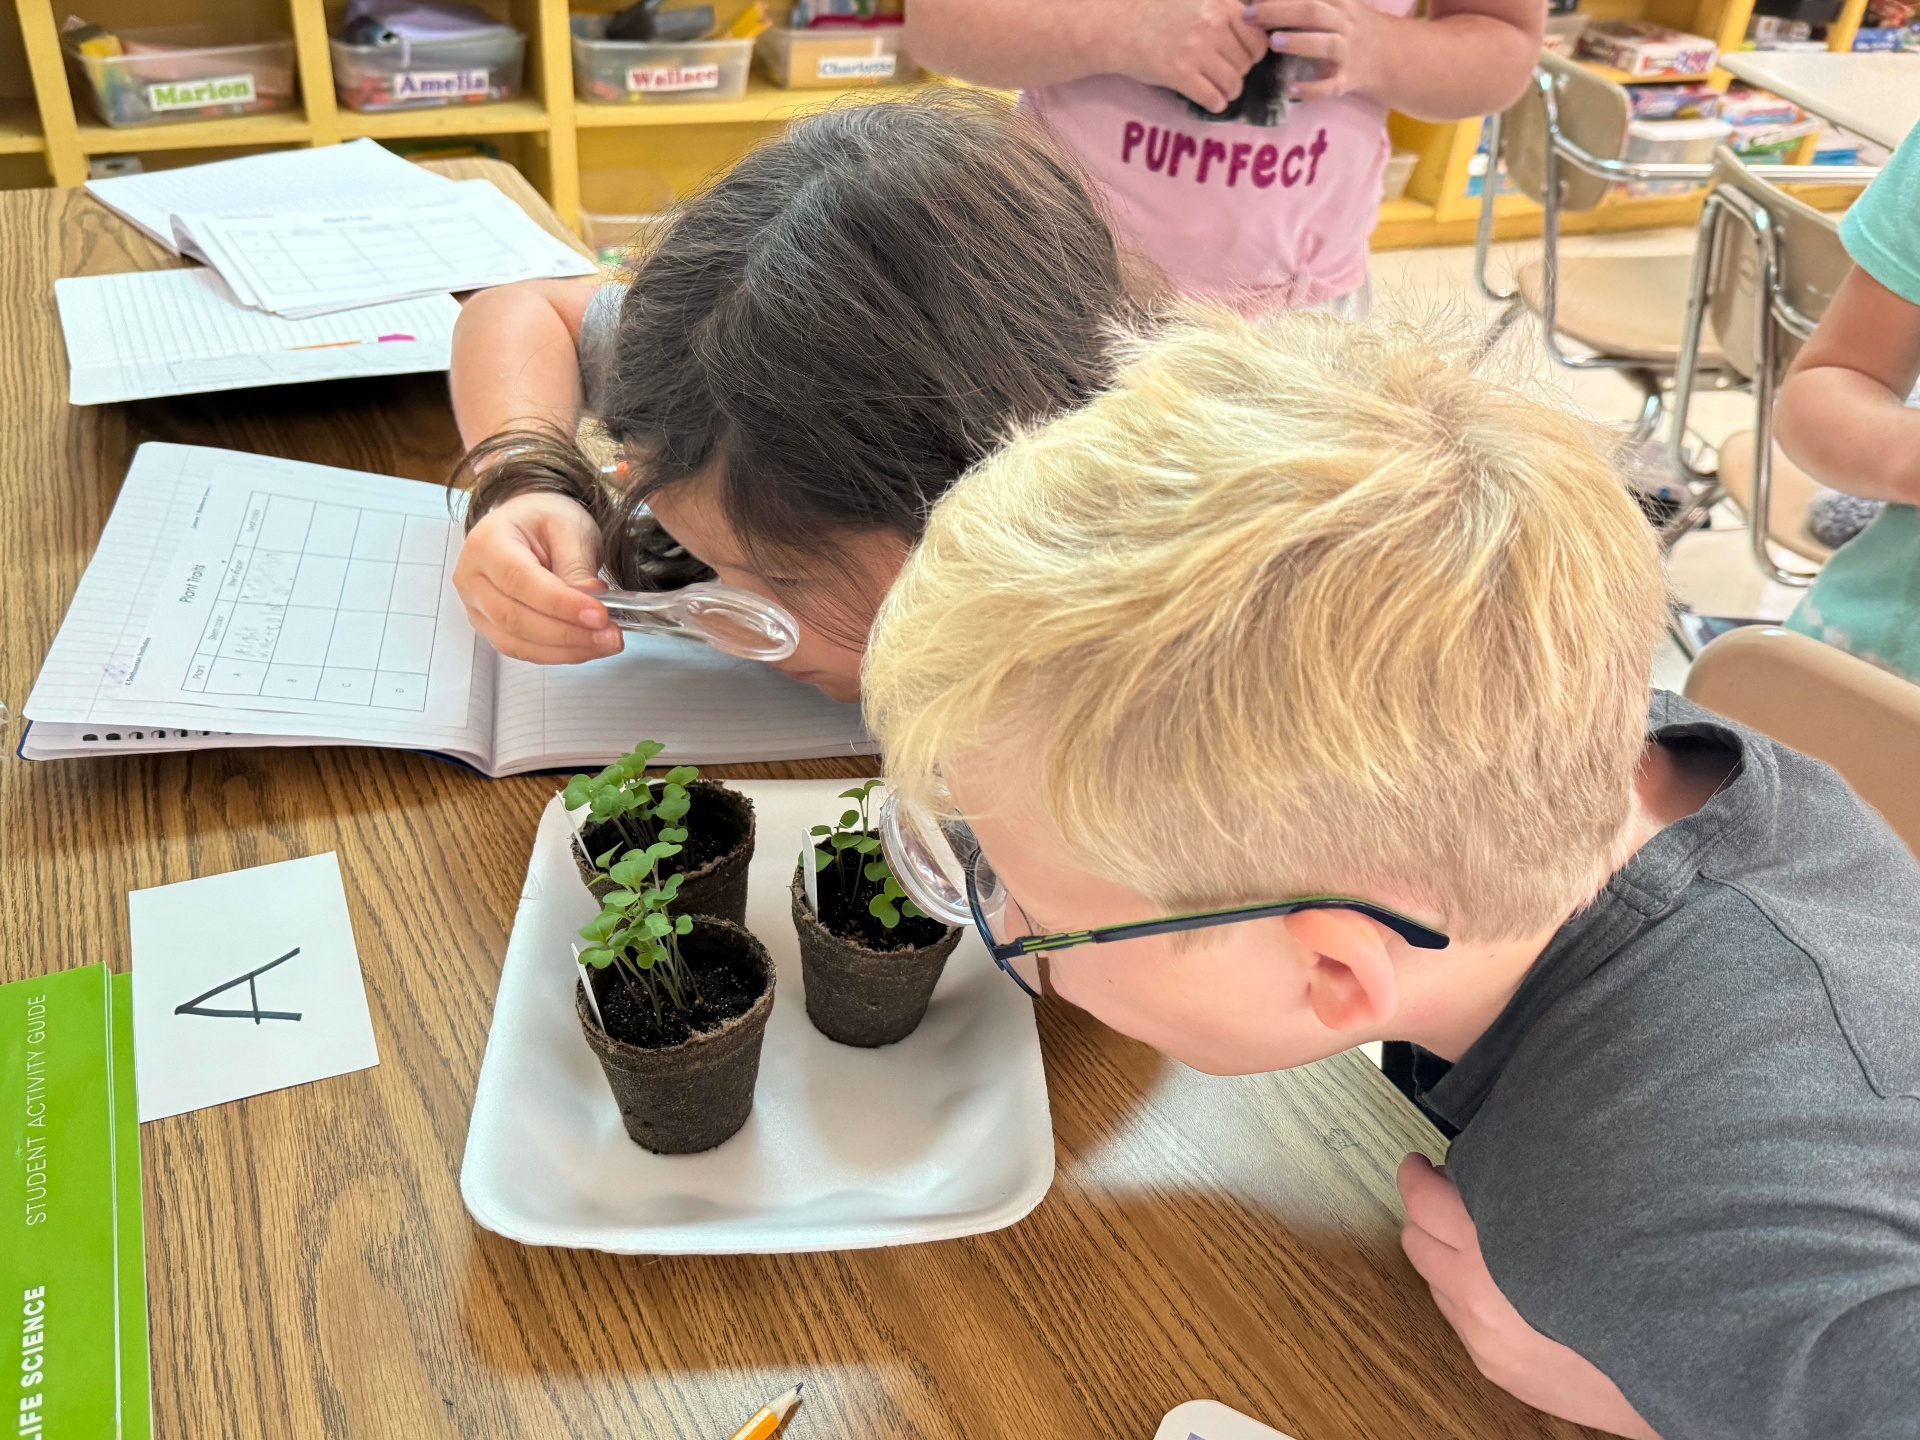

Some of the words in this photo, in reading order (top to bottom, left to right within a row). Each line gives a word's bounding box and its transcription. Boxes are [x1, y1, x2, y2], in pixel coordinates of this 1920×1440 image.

[152, 79, 250, 107] Marion
[399, 71, 486, 94] Amelia
[631, 67, 716, 88] Wallace
[179, 582, 195, 604] Plant
[187, 564, 206, 588] Traits
[192, 664, 206, 681] Plant
[174, 946, 302, 1025] A
[27, 994, 46, 1044] GUIDE
[26, 1051, 46, 1127] ACTIVITY
[26, 1136, 47, 1226] STUDENT
[20, 1285, 46, 1388] SCIENCE
